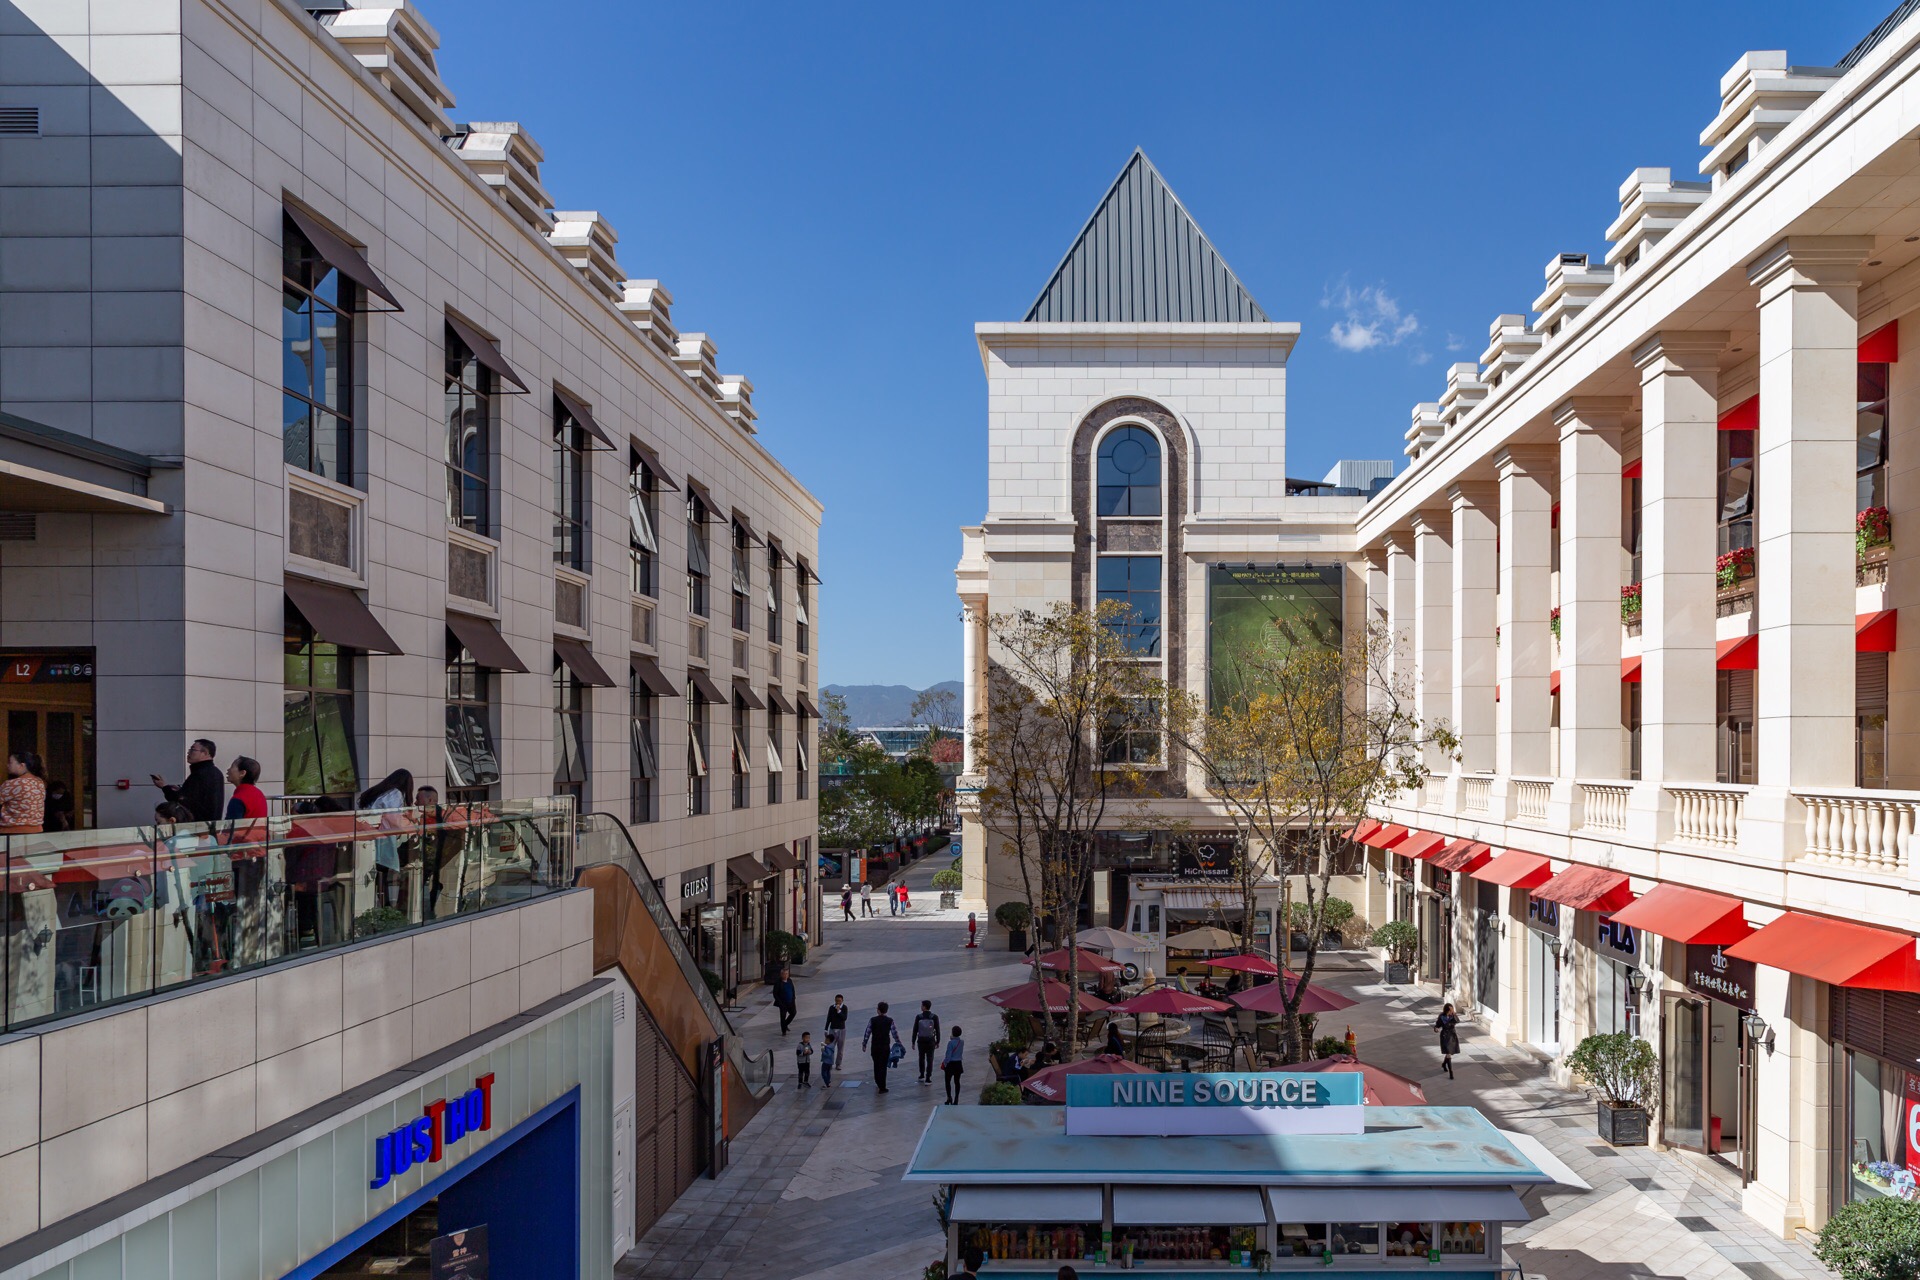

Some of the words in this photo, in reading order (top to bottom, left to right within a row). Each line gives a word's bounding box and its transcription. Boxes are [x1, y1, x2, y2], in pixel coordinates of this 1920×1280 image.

[16, 664, 30, 676] L2
[684, 876, 708, 898] GUESS
[1529, 895, 1558, 928] FILA
[1599, 914, 1636, 955] FILA
[1113, 1080, 1184, 1103] NINE
[1194, 1078, 1317, 1103] SOURCE
[370, 1099, 446, 1189] JUST
[445, 1072, 495, 1144] HOT
